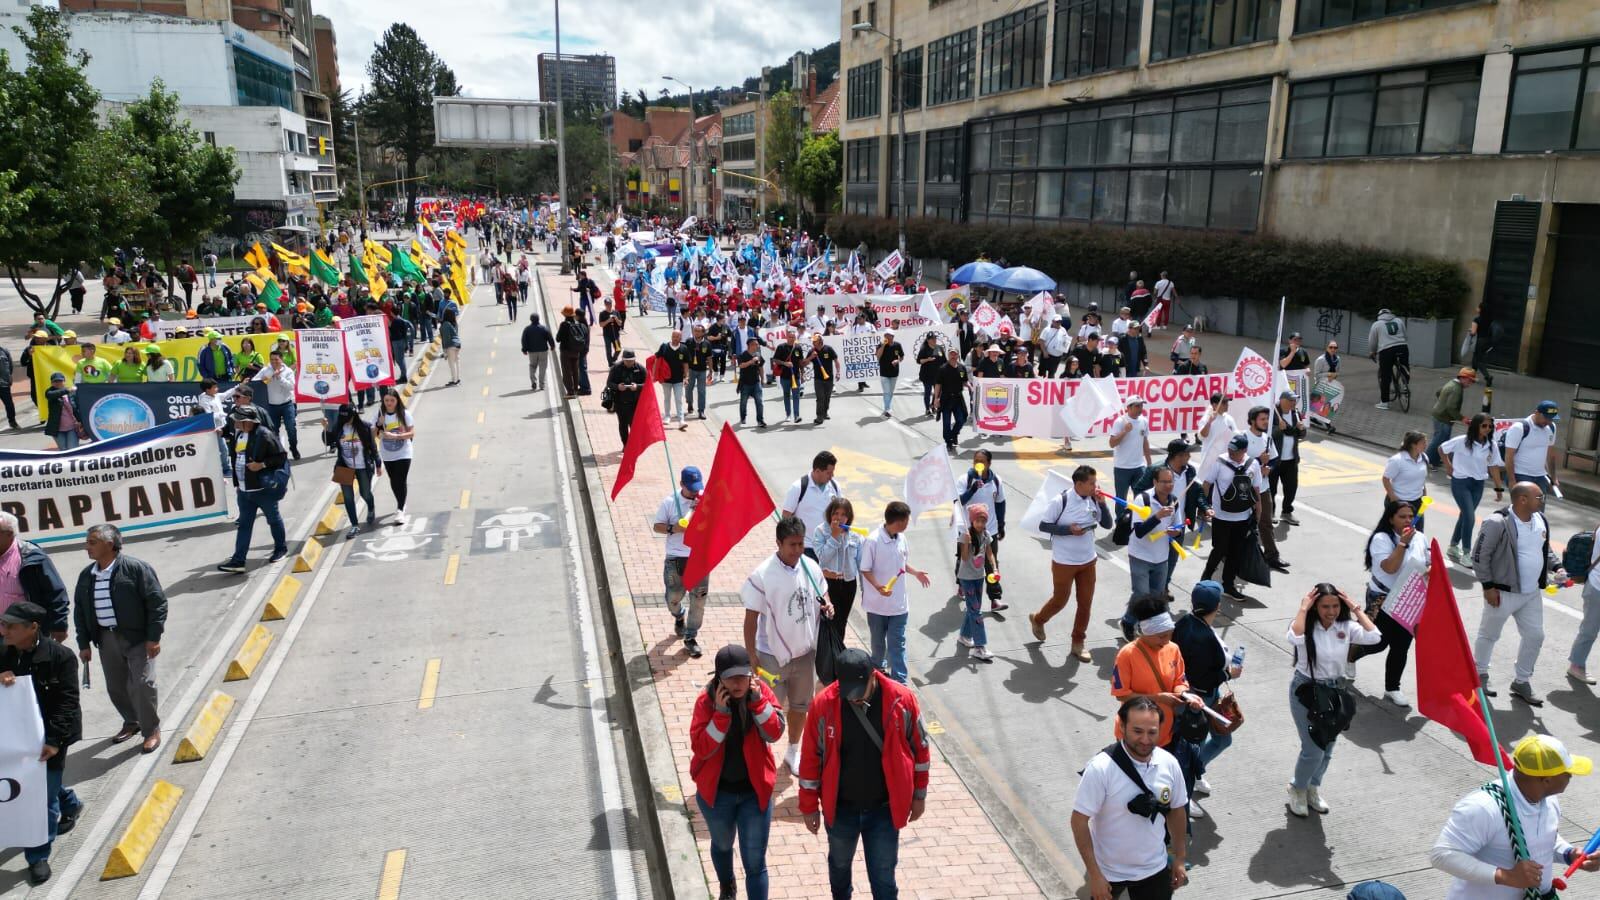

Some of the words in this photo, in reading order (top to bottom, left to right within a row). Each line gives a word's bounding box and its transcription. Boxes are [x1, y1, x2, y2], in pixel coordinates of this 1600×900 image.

[900, 305, 912, 313] en
[38, 462, 63, 476] de
[68, 443, 196, 473] Trabajadores
[55, 474, 99, 488] Distrital
[102, 473, 115, 482] de
[118, 464, 177, 481] Planeación
